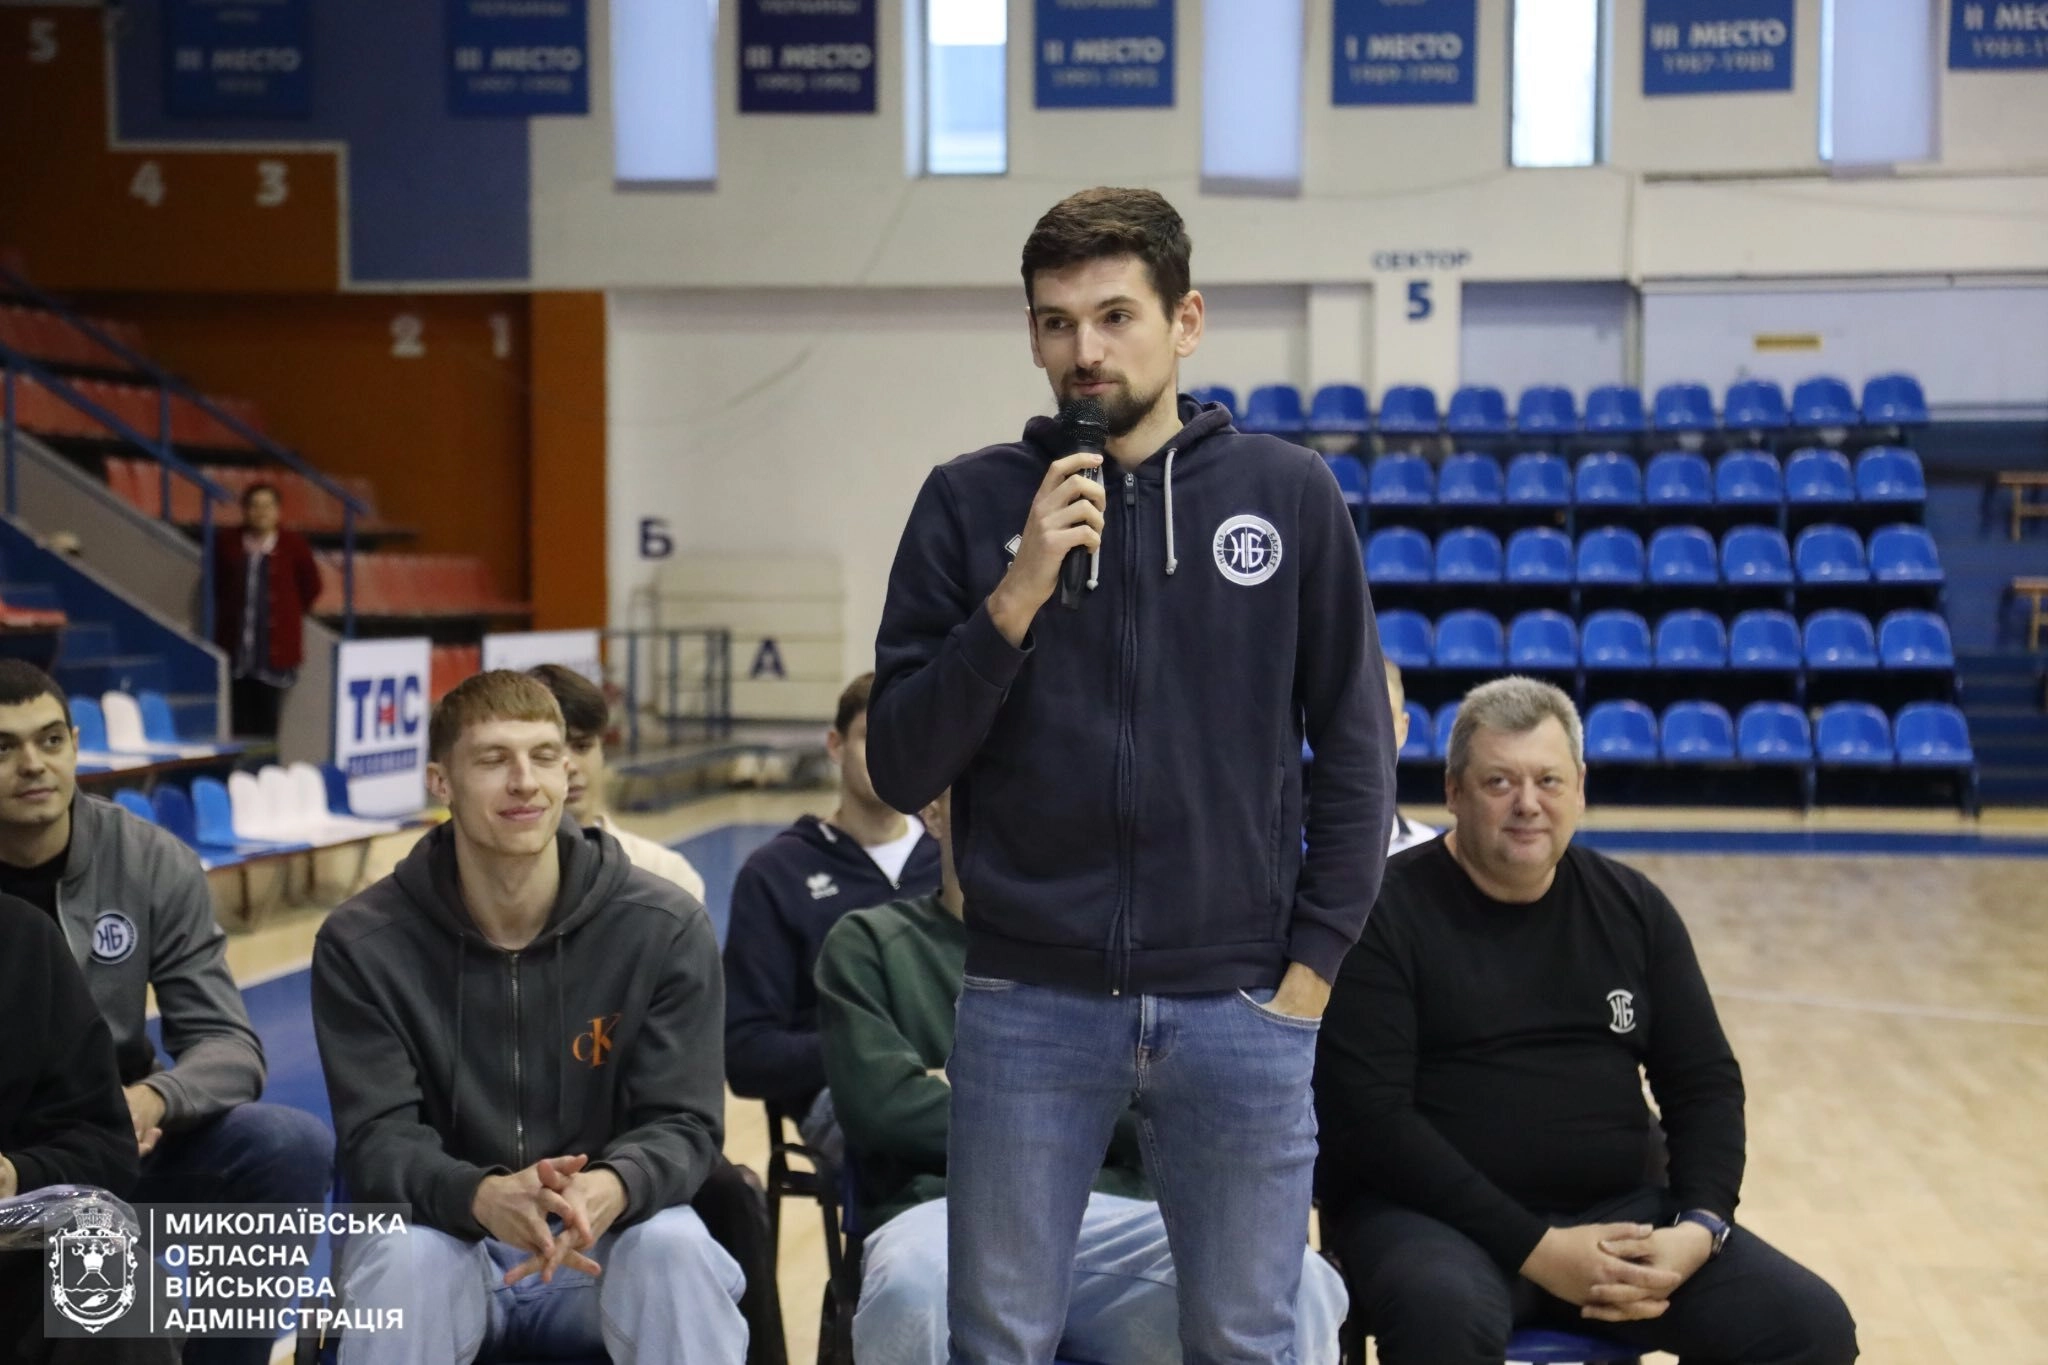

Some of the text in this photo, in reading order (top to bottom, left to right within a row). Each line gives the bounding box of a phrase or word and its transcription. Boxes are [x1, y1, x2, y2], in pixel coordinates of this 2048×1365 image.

[28, 18, 60, 63] 5
[1071, 36, 1166, 64] МЕСТО
[1344, 31, 1463, 61] I МЕСТО
[1650, 18, 1787, 50] III МЕСТО
[211, 47, 302, 71] МЕСТО
[491, 46, 582, 71] МЕСТО
[781, 43, 872, 69] МЕСТО
[129, 161, 166, 207] 4
[256, 161, 289, 207] 3
[1372, 249, 1471, 271] СЕКТОР
[1407, 281, 1432, 319] 5
[390, 313, 426, 358] 2
[488, 313, 511, 358] 1
